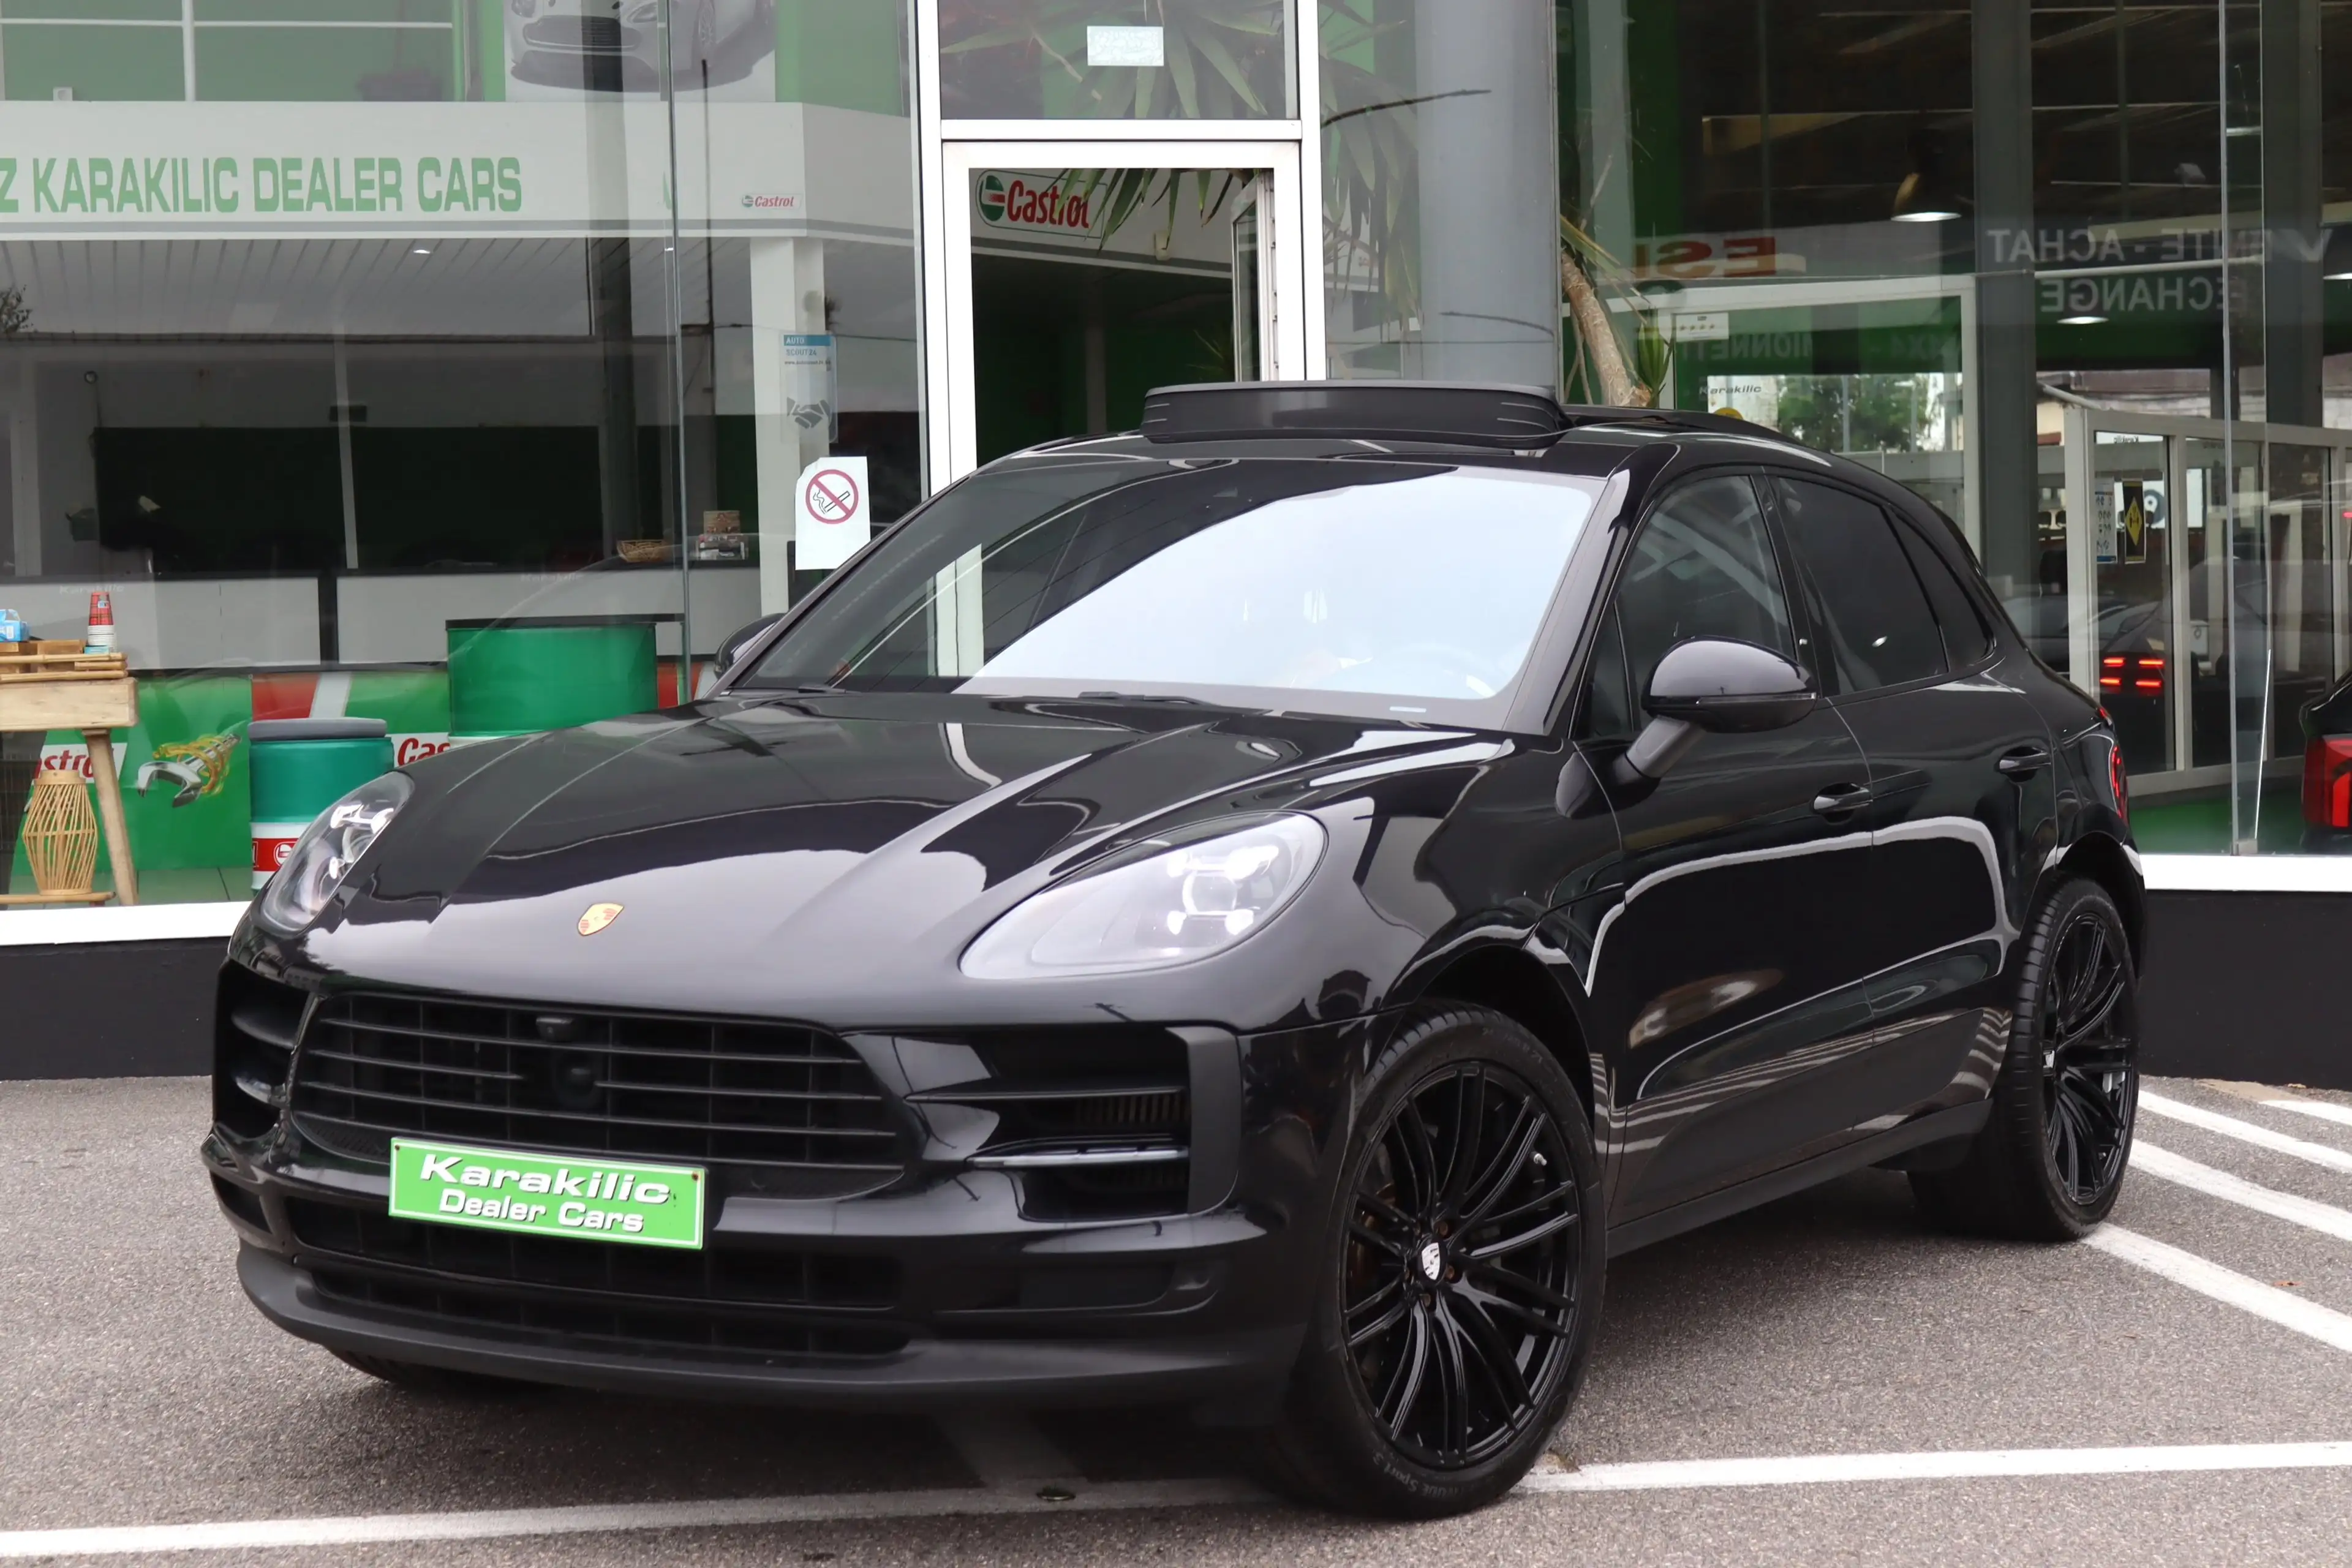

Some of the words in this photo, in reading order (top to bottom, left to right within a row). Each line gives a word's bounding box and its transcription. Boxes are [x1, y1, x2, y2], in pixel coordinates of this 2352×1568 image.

[33, 157, 239, 213] KARAKILIC
[253, 157, 403, 212] DEALER
[417, 157, 522, 212] CARS
[755, 195, 794, 208] Castrol
[1699, 385, 1762, 394] Karakilic
[420, 1152, 671, 1205] Karakilic
[439, 1188, 547, 1224] Dealer
[557, 1200, 644, 1233] Cars
